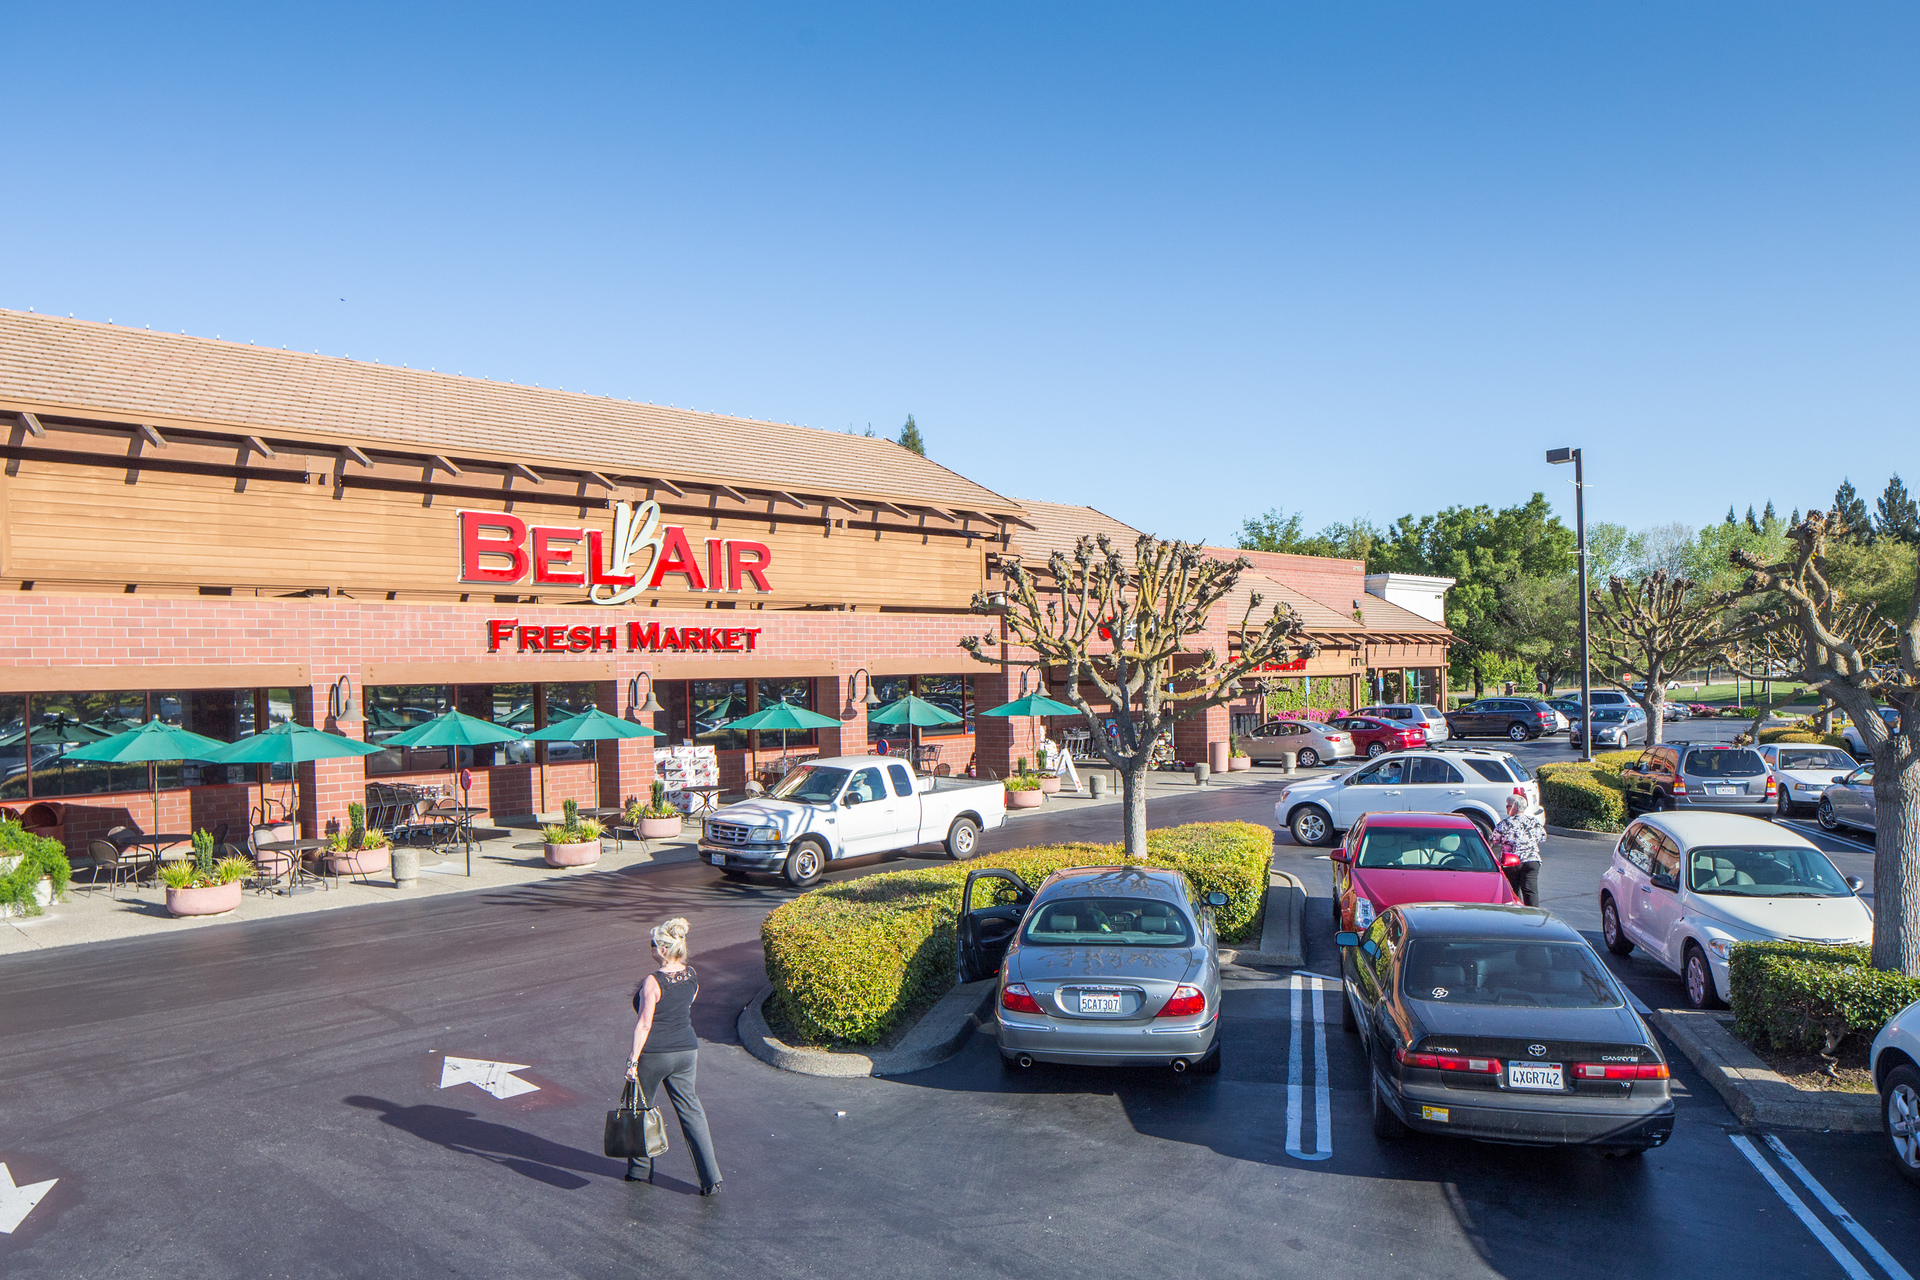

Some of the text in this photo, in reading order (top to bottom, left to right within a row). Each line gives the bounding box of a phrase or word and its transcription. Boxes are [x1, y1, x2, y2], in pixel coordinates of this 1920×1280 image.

[456, 508, 774, 594] BEL AIR
[487, 618, 762, 653] FRESH MARKET
[1082, 998, 1119, 1011] 5CAT307
[1512, 1070, 1560, 1086] 4XGR742
